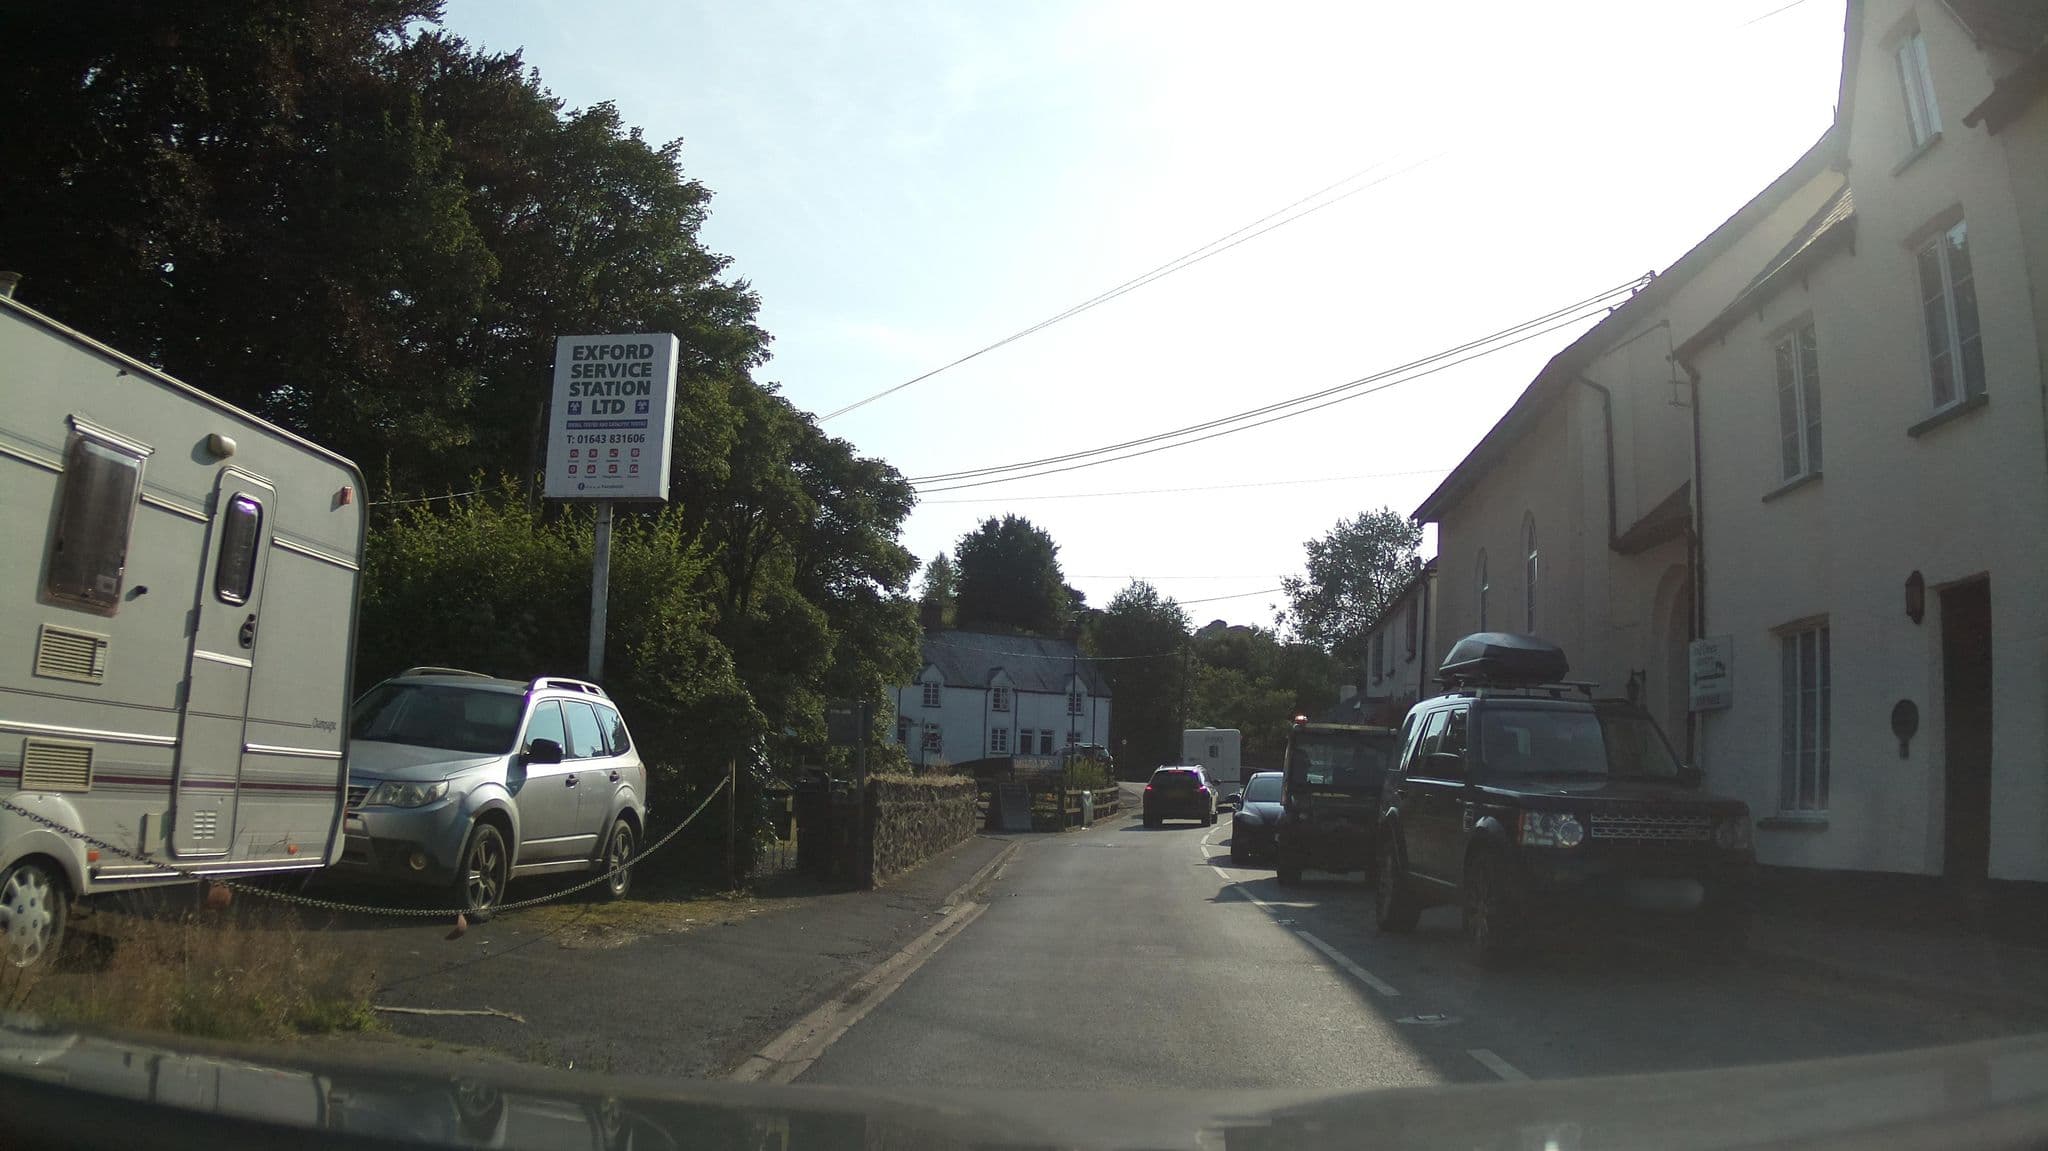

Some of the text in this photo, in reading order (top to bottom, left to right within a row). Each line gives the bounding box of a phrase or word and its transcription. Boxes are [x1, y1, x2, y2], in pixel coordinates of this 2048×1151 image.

[572, 344, 654, 361] EXFORD
[570, 362, 653, 379] SERVICE
[569, 380, 651, 397] STATION
[591, 399, 626, 415] LTD
[566, 433, 646, 445] T: 01643 831606
